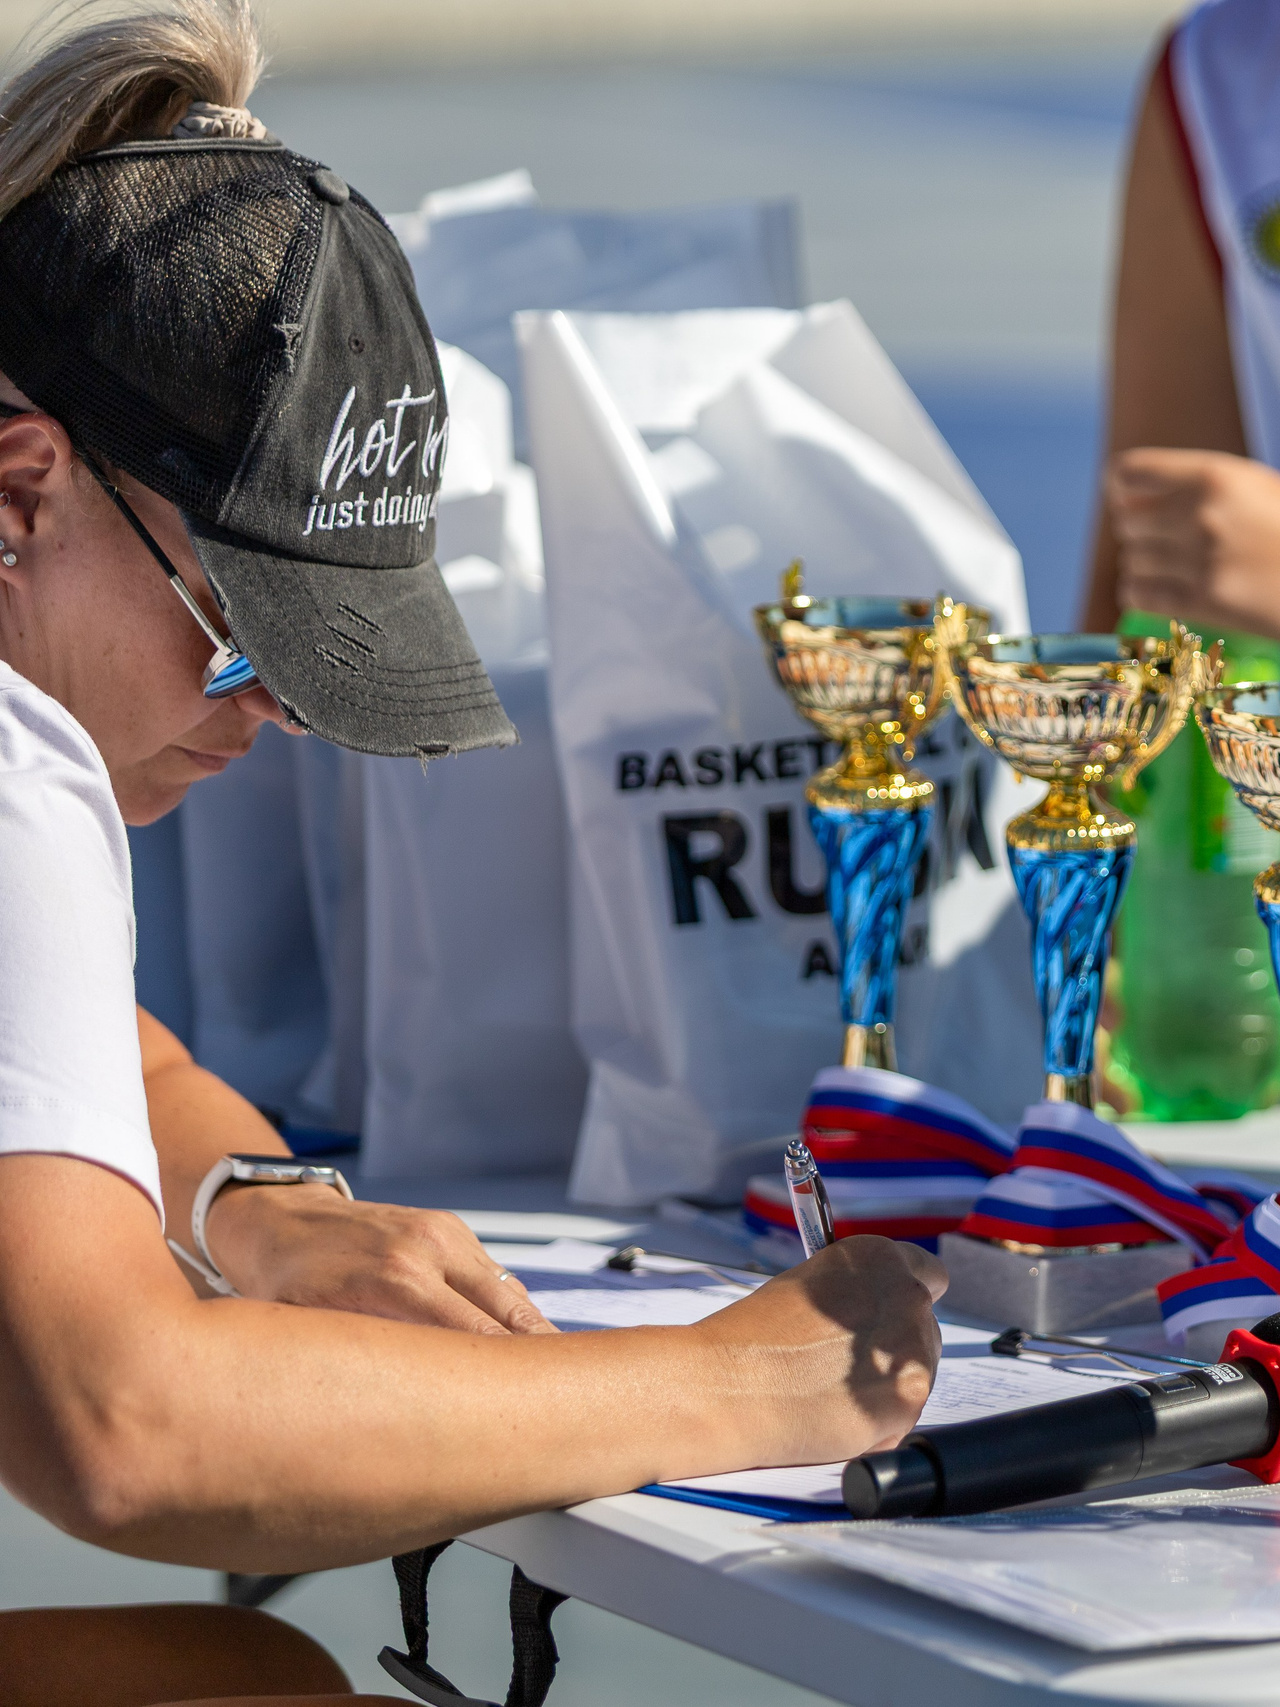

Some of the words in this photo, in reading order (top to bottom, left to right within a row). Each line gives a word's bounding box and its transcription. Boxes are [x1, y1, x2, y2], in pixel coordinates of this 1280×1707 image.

[319, 383, 436, 491] hot
[302, 491, 369, 536] just
[372, 485, 428, 533] doing
